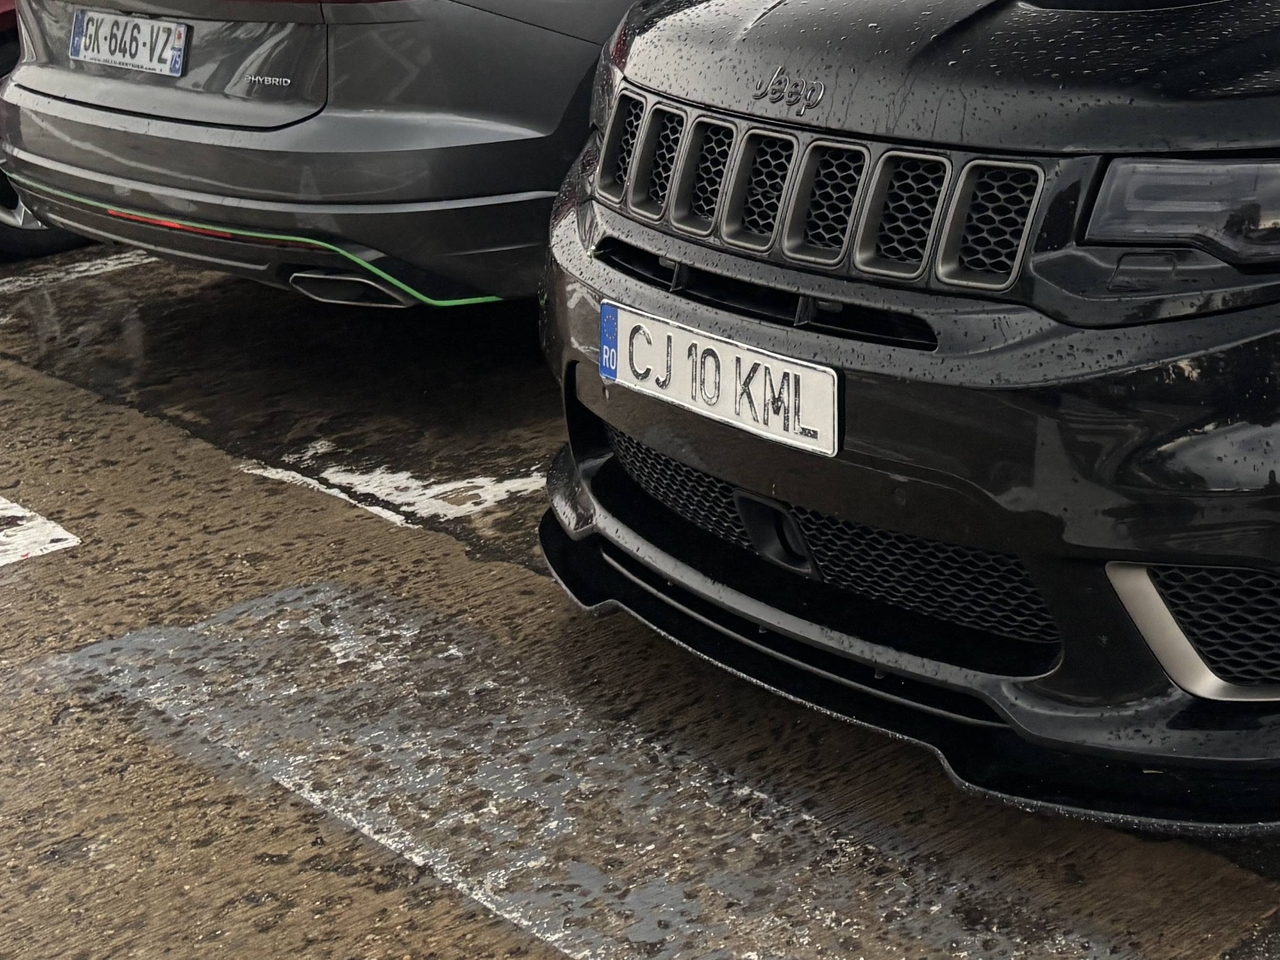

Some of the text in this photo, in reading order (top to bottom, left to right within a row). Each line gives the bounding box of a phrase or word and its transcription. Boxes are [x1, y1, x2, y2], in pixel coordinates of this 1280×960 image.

[170, 54, 181, 69] 75
[752, 65, 825, 117] Jeep
[602, 345, 617, 370] RO
[628, 323, 819, 440] CJ 10 KML
